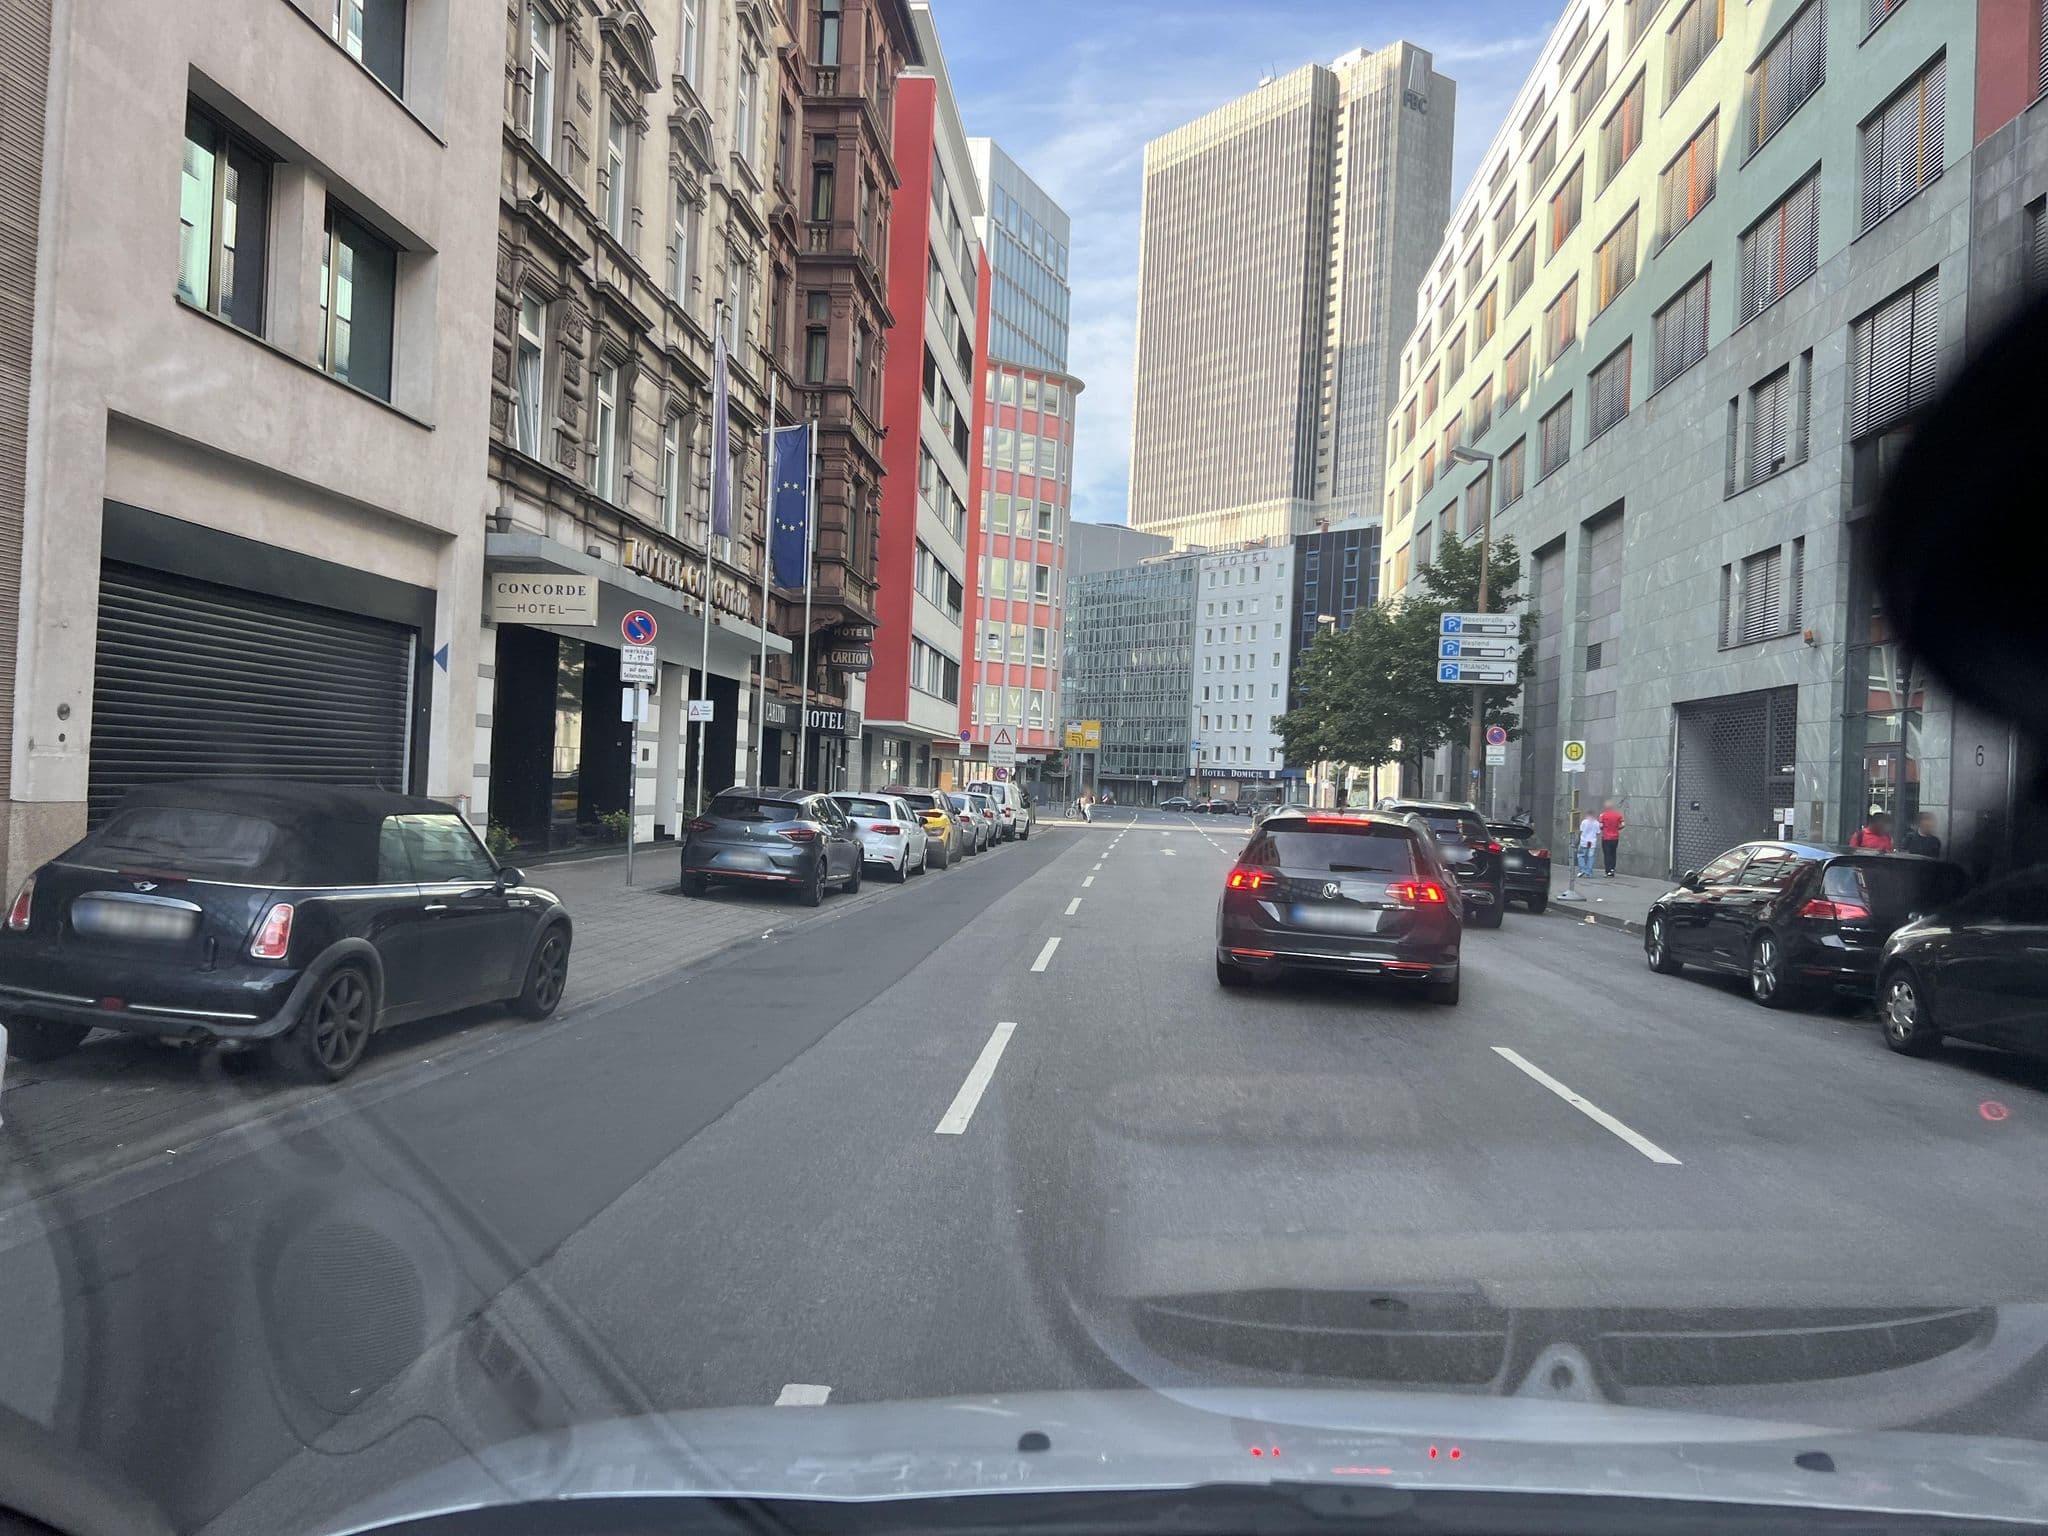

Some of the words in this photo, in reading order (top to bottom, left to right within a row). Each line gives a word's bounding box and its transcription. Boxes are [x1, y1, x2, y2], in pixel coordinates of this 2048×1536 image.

[625, 537, 682, 587] HOTEL
[497, 583, 587, 596] CONCORDE
[517, 603, 565, 614] HOTEL
[833, 626, 870, 637] HOTEL
[831, 651, 869, 664] CARLTON
[1975, 744, 1985, 767] 6
[1202, 768, 1226, 777] HOTEL
